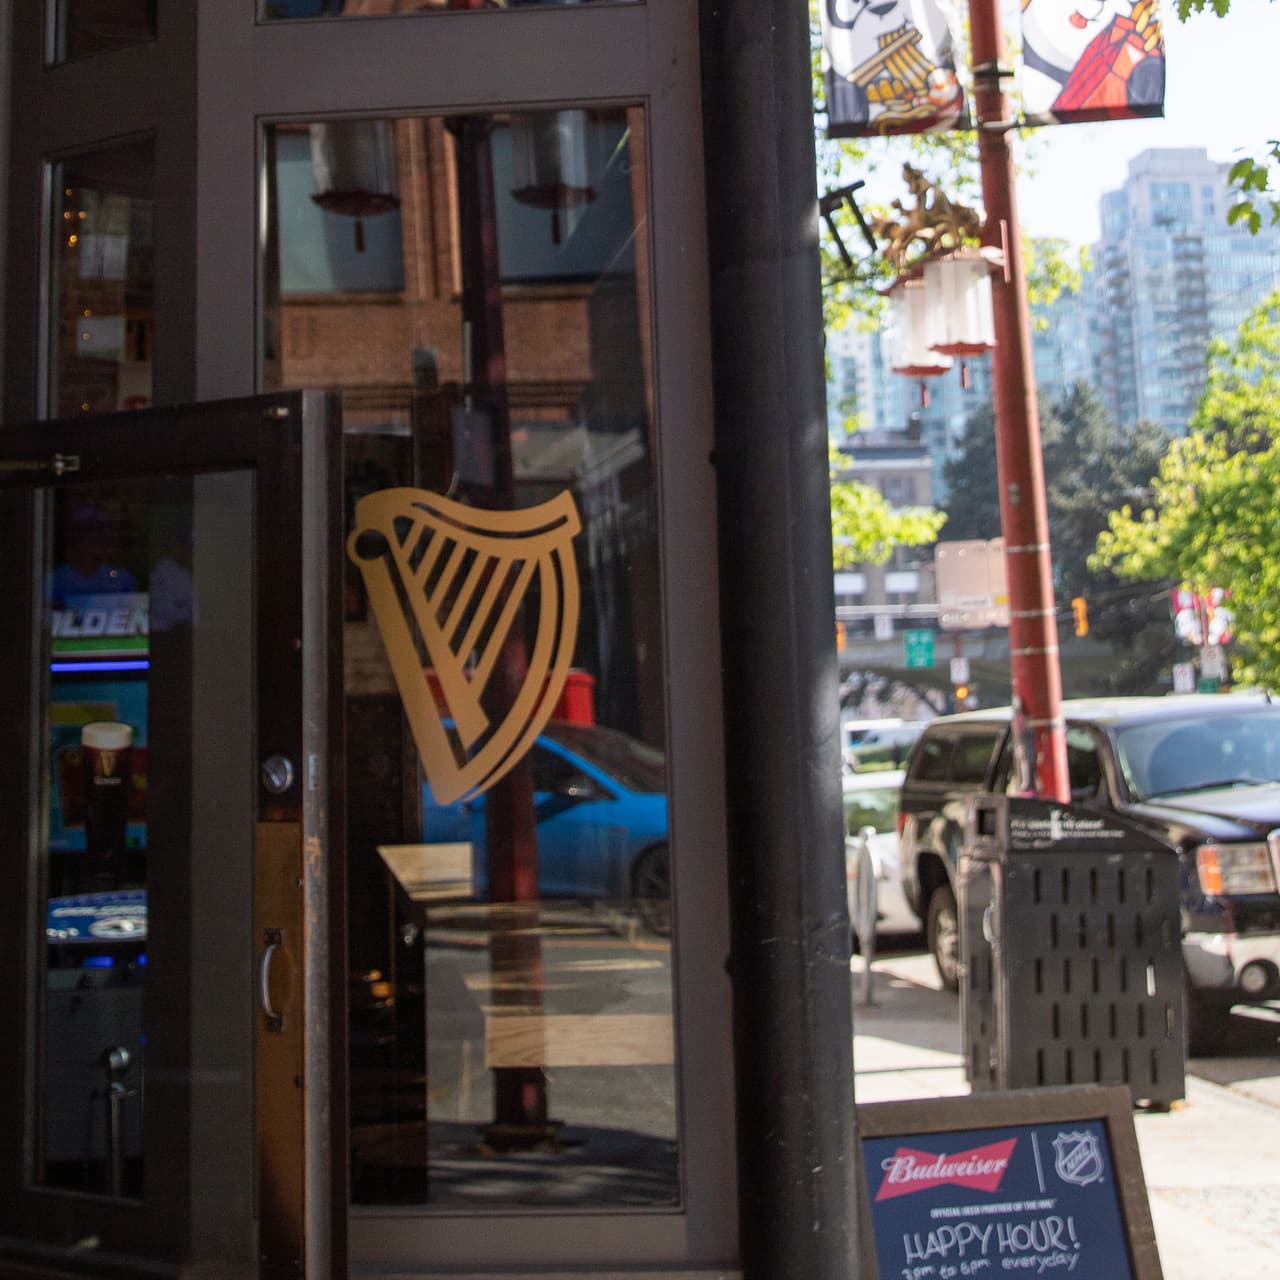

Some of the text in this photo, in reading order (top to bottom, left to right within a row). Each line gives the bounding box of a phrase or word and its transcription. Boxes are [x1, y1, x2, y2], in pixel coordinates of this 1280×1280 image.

[881, 1152, 1008, 1184] Budweiser
[903, 1216, 1081, 1264] HAPPY HOUR!
[939, 1265, 957, 1279] to
[1001, 1251, 1080, 1275] everyday
